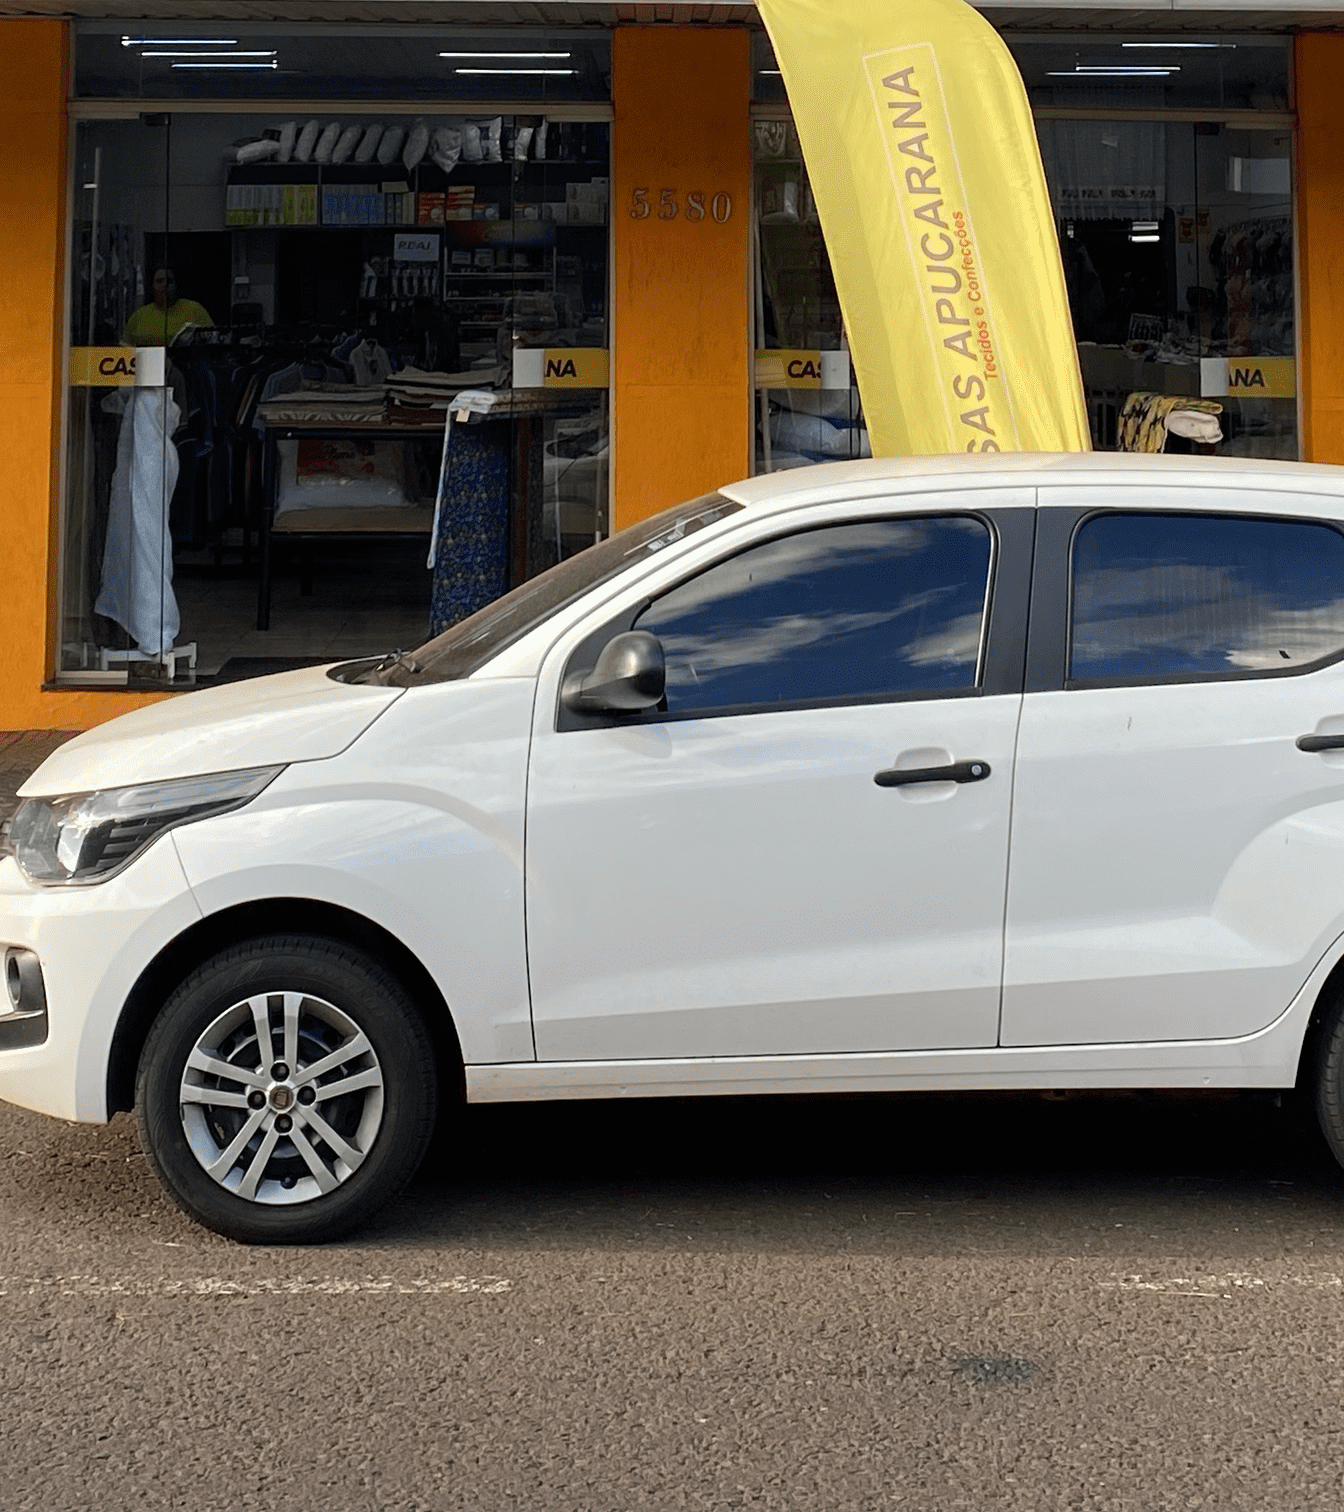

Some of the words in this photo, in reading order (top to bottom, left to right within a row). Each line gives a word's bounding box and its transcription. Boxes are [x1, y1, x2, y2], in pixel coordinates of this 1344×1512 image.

[630, 186, 733, 224] 5580
[882, 66, 978, 362] APUCARANA
[952, 210, 982, 303] Confecções
[974, 307, 984, 316] e
[787, 359, 822, 379] CA
[975, 320, 998, 381] Tecidos
